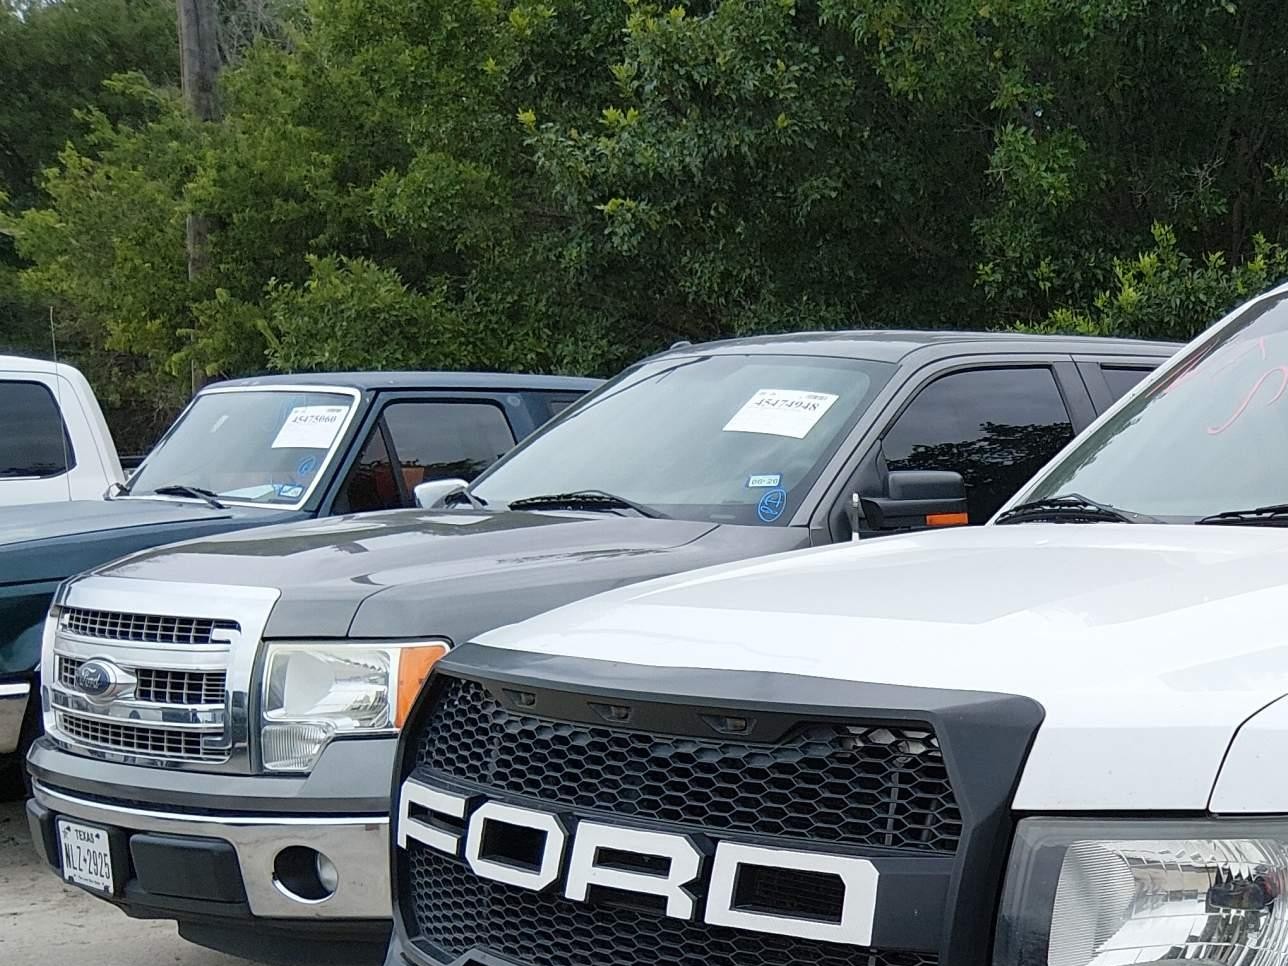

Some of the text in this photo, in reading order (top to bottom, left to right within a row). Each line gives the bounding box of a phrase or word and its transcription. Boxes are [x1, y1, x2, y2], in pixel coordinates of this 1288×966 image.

[753, 398, 820, 412] 45474948
[75, 828, 95, 843] TEXAS
[396, 776, 881, 947] FORD
